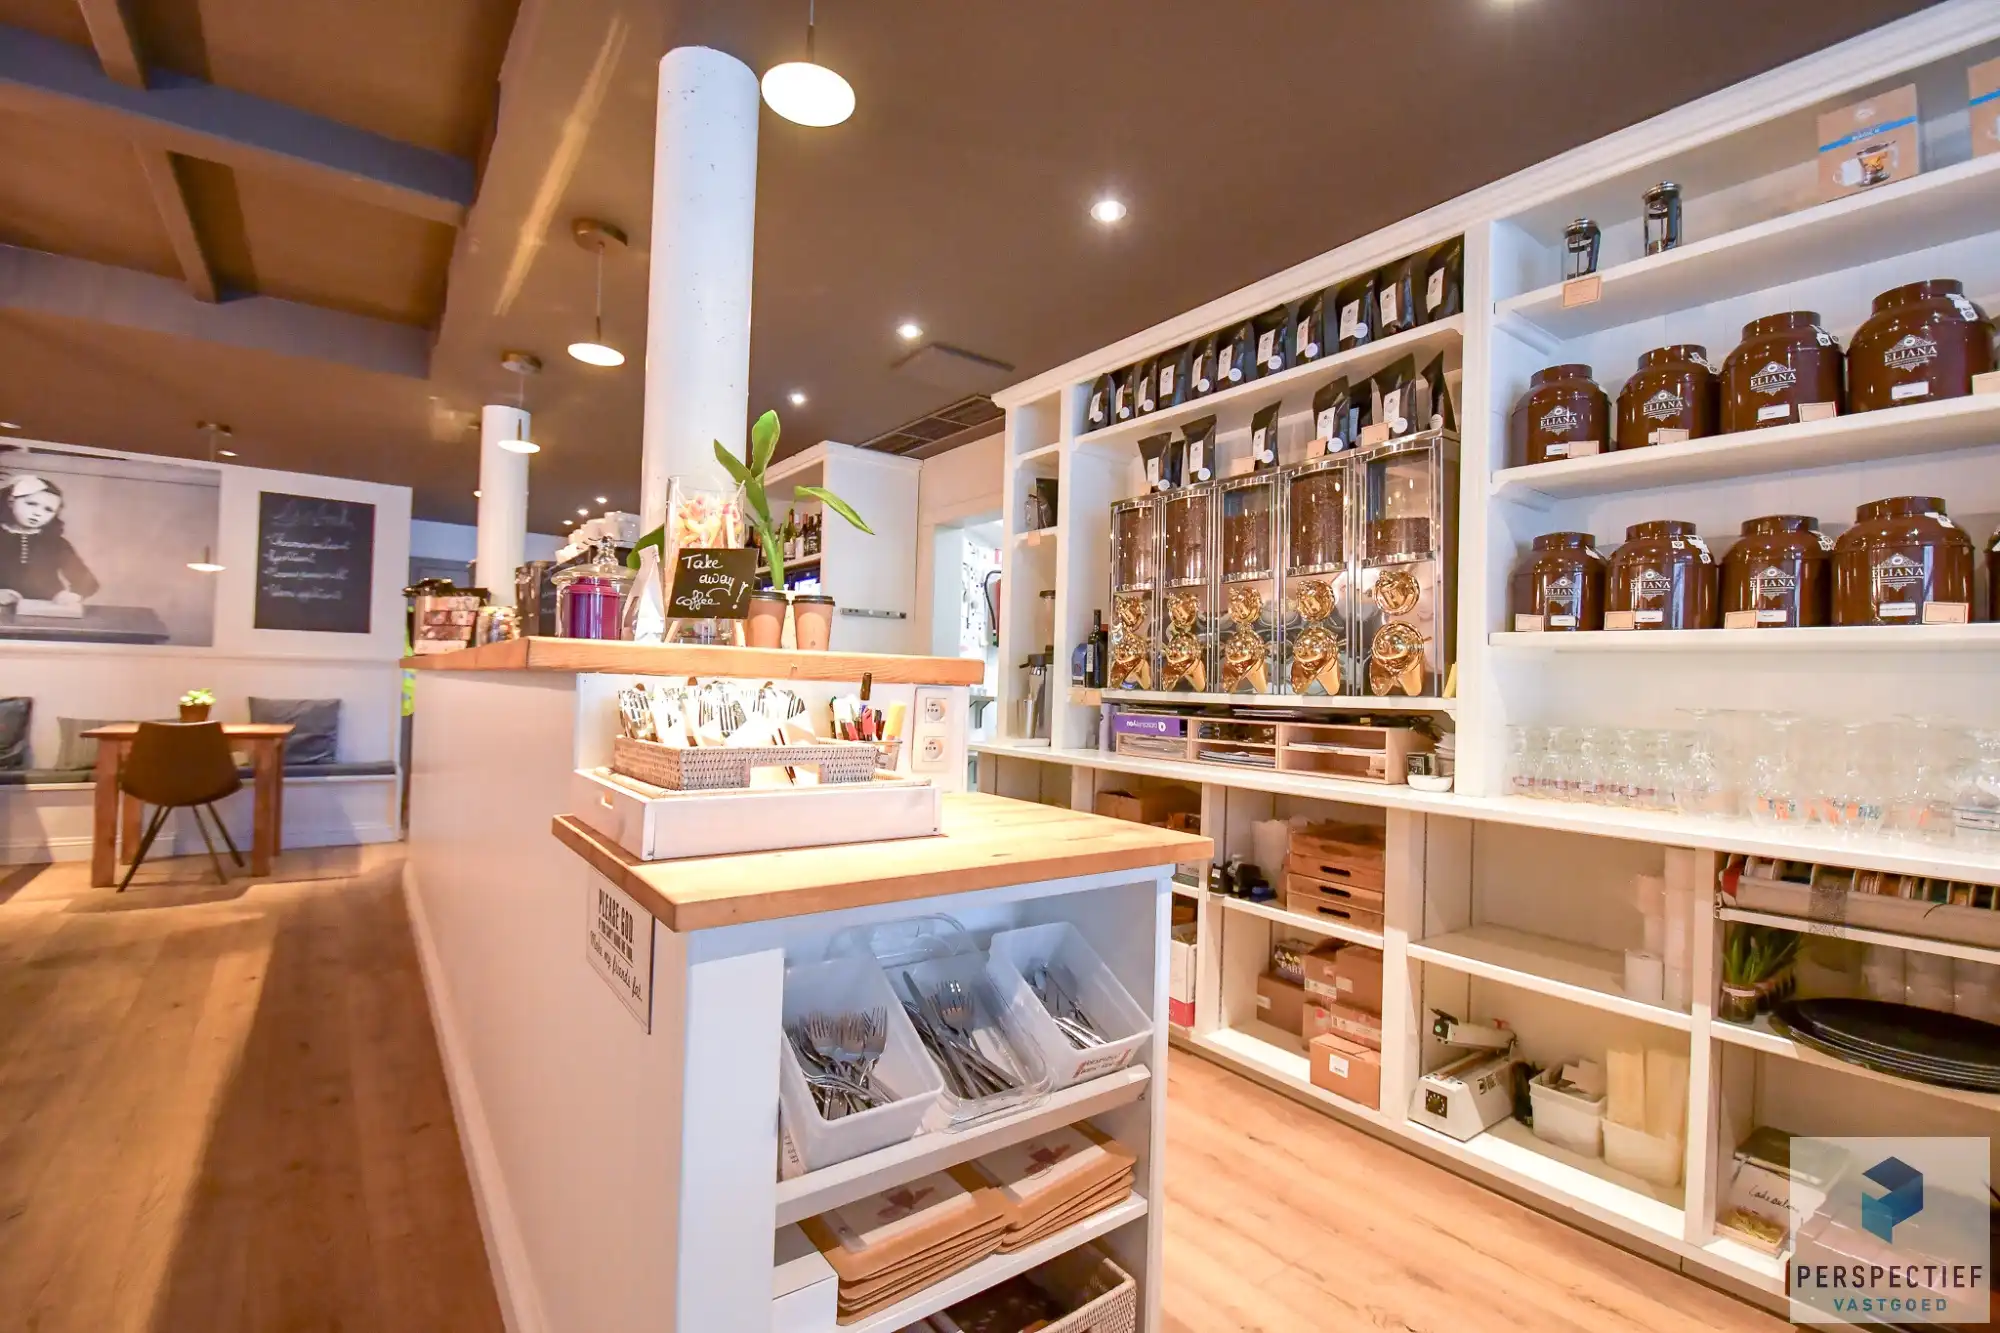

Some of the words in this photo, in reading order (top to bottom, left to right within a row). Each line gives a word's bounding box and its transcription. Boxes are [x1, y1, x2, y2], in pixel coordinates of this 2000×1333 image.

[1884, 345, 1938, 364] ELIANA
[1750, 371, 1797, 388] ELIANA
[1643, 399, 1683, 413] ELIANA
[1540, 415, 1577, 428] ELIANA
[681, 553, 723, 569] Take
[1872, 567, 1924, 578] ELIANA
[699, 573, 735, 597] away
[1630, 580, 1671, 590] ELIANA
[1750, 578, 1796, 588] ELIANA
[1545, 587, 1582, 596] ELIANA
[676, 590, 721, 611] coffee
[598, 888, 620, 931] PLEASE
